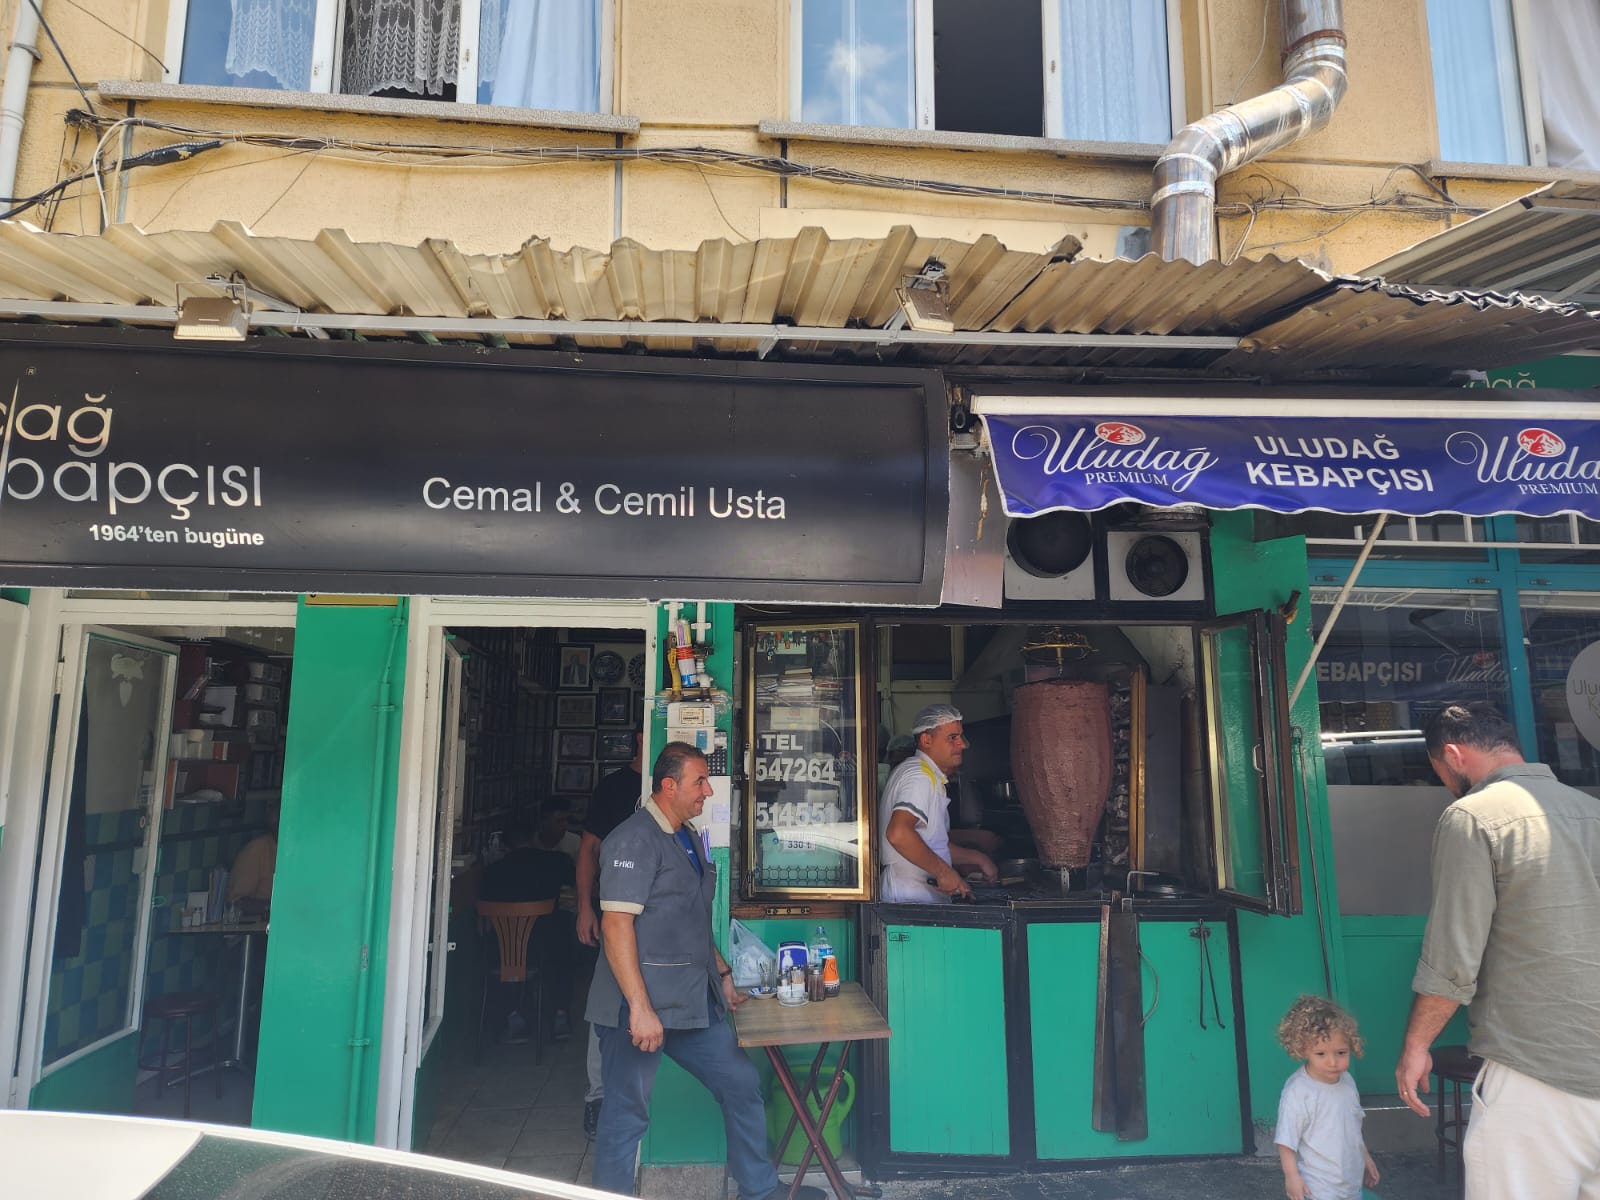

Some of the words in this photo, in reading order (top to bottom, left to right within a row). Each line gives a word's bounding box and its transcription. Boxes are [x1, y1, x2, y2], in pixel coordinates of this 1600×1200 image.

[1012, 425, 1220, 493] Uludağ
[1254, 433, 1400, 460] ULUDAĞ
[1085, 471, 1169, 486] PREMIUM
[1245, 461, 1434, 496] KEBAPÇISI
[1517, 482, 1599, 495] PREMIUM
[422, 476, 542, 512] Cemal
[555, 481, 582, 514] &
[594, 483, 695, 517] Cemil
[708, 487, 787, 519] Usta
[184, 527, 265, 549] bugüne
[762, 734, 804, 751] TEL
[755, 757, 836, 784] 547264
